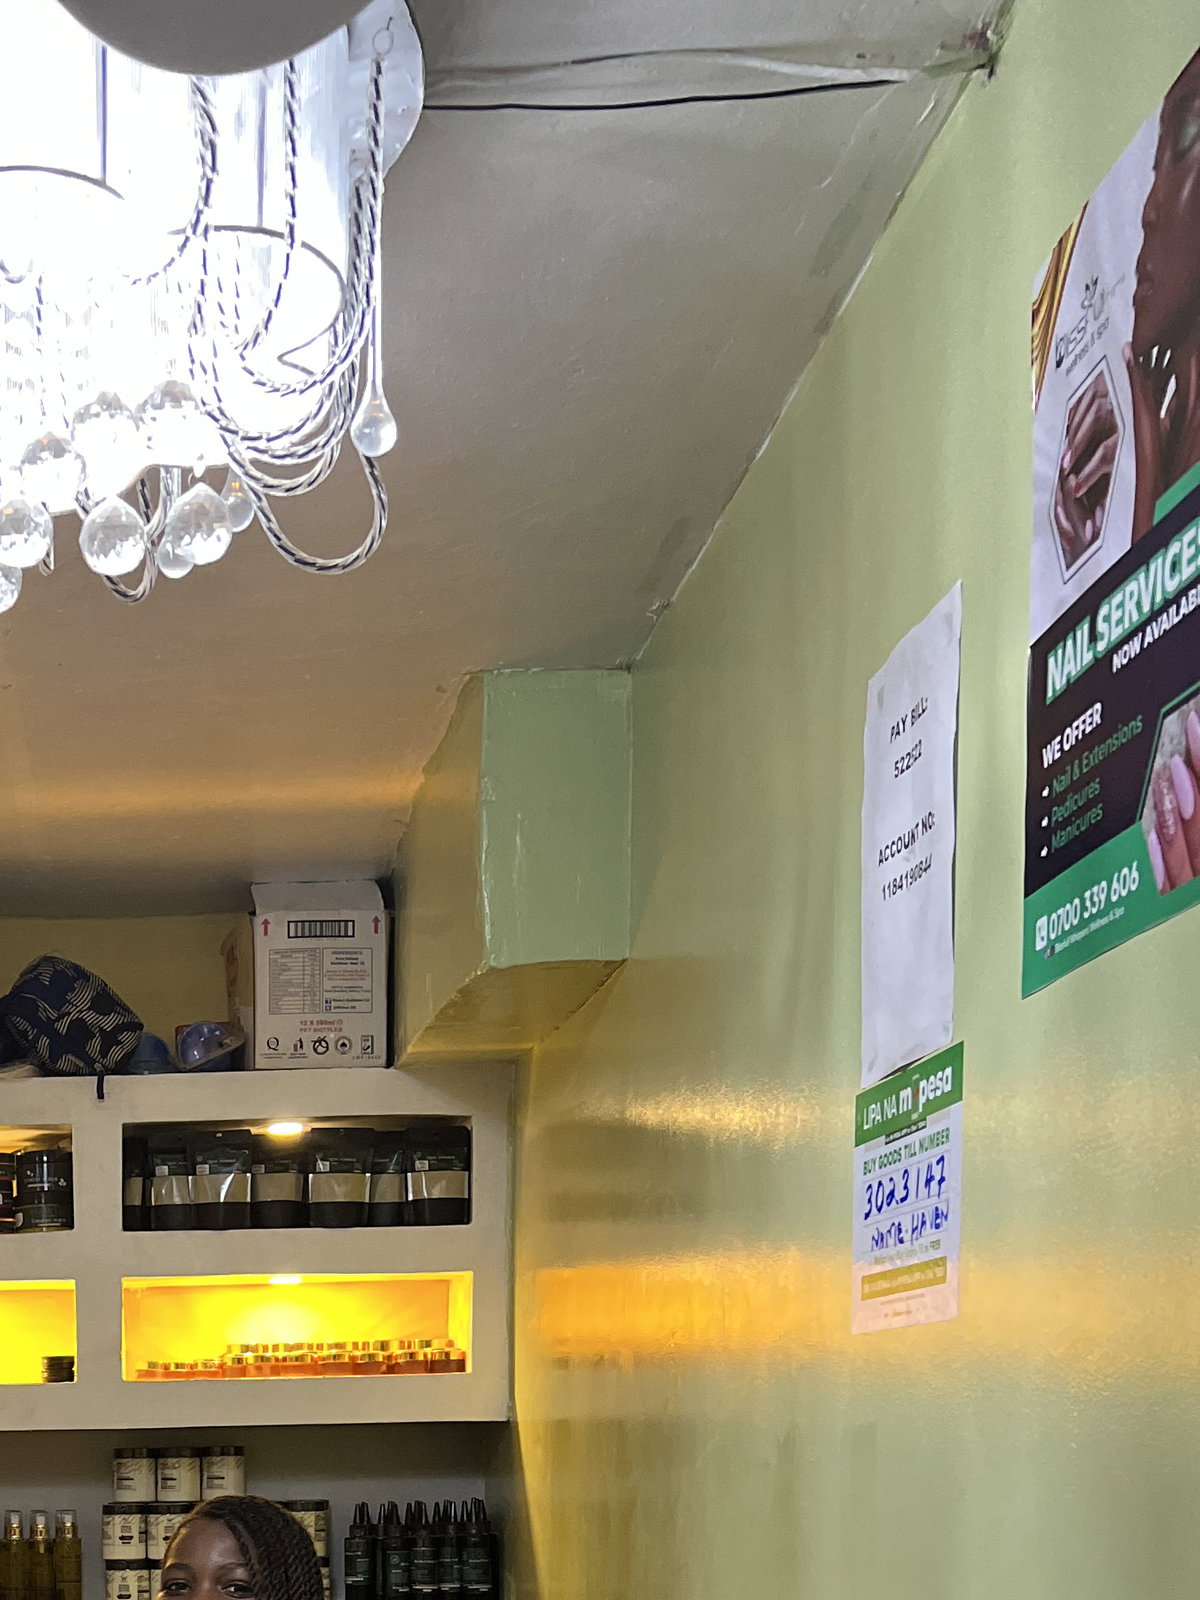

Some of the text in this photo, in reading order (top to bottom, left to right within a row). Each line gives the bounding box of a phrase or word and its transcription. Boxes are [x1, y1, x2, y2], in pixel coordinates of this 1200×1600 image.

[1047, 525, 1200, 699] NAIL SERVICE
[1112, 632, 1142, 673] NOW
[889, 696, 928, 744] PAY BILL:
[1042, 702, 1102, 769] WE OFFER
[1052, 714, 1143, 797] Nail & Extensions
[1051, 778, 1100, 828] Pedicures
[1051, 803, 1103, 853] Manicures
[878, 823, 919, 867] ACCOUNT
[1049, 897, 1080, 941] 0700
[1083, 880, 1108, 919] 339
[1110, 860, 1140, 903] 606
[863, 1101, 882, 1130] LIPA
[883, 1094, 897, 1121] NA
[863, 1157, 879, 1176] BUY
[878, 1147, 902, 1170] GOODS
[904, 1140, 917, 1159] TILL
[919, 1127, 951, 1154] NUMBER
